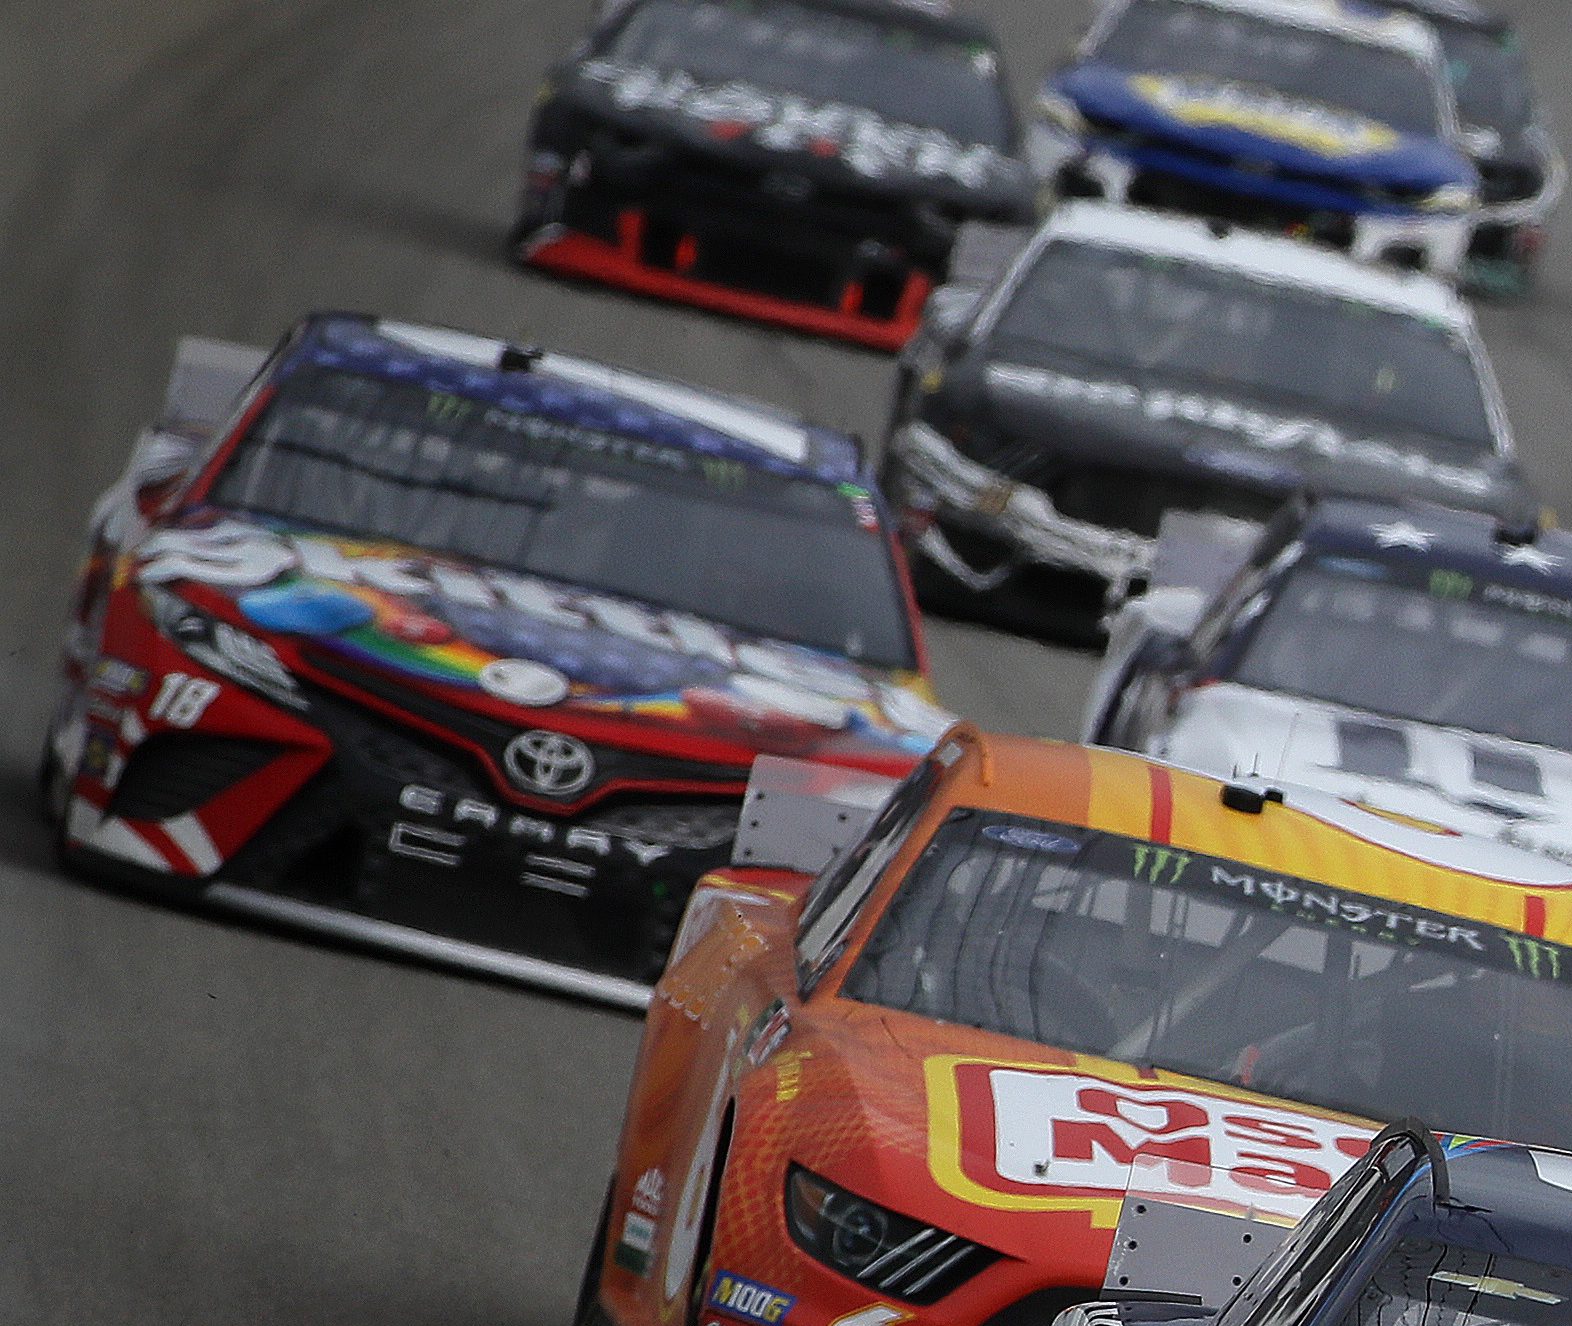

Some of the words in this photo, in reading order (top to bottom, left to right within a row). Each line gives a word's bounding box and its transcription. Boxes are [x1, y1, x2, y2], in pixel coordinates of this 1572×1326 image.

[149, 671, 223, 730] 18
[1210, 865, 1484, 951] MONSTER
[712, 1277, 790, 1324] MOOG
